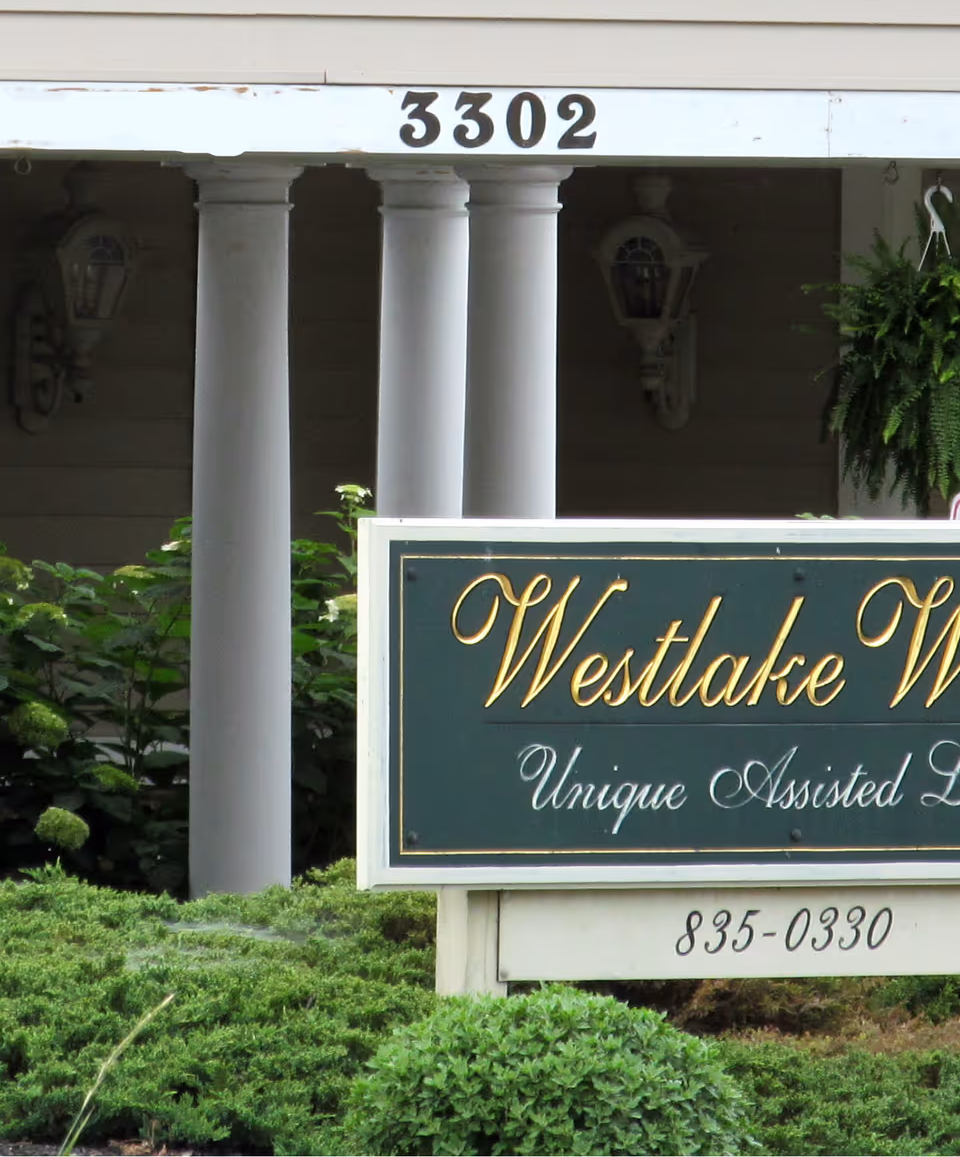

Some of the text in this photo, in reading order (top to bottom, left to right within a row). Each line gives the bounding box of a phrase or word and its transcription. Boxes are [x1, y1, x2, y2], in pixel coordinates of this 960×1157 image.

[400, 91, 597, 149] 3302
[451, 572, 845, 710] Westlake
[517, 742, 687, 834] Unique
[709, 744, 913, 811] Assisted
[675, 905, 894, 957] 835-0330
